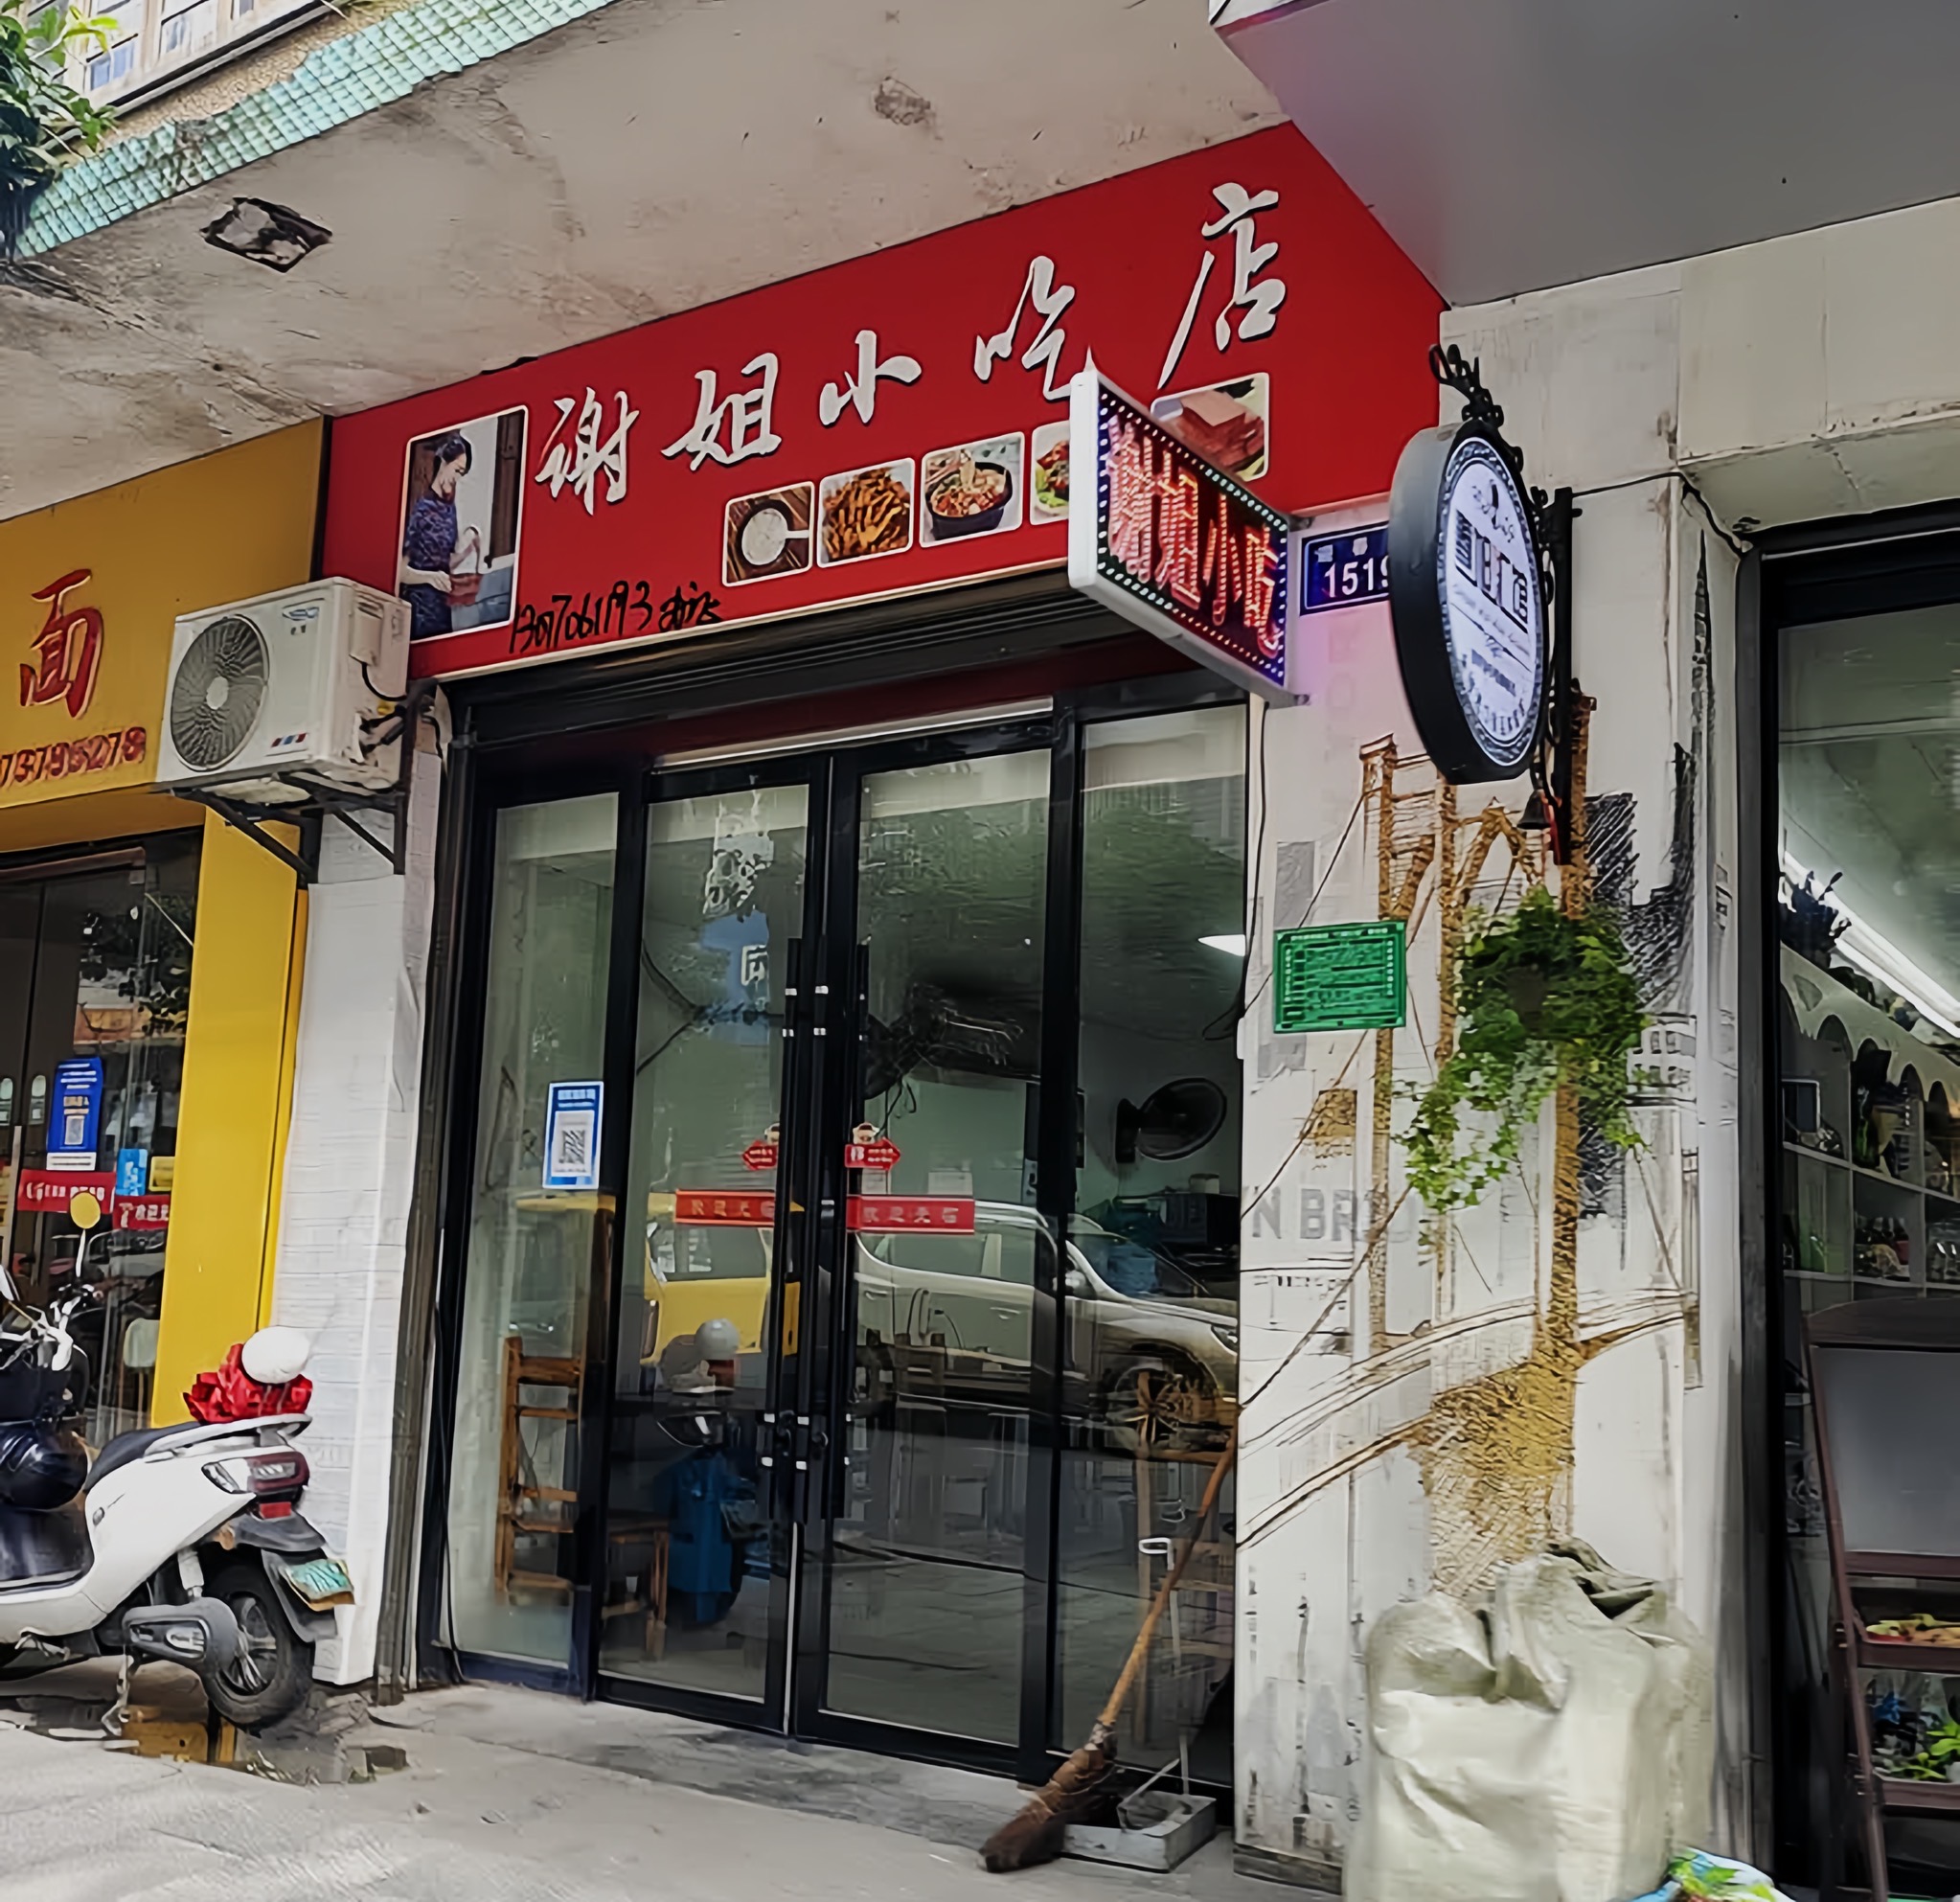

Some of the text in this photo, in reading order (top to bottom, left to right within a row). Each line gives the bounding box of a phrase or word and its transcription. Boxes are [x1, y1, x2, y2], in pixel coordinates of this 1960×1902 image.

[535, 182, 1287, 516] 谢姐小吃店
